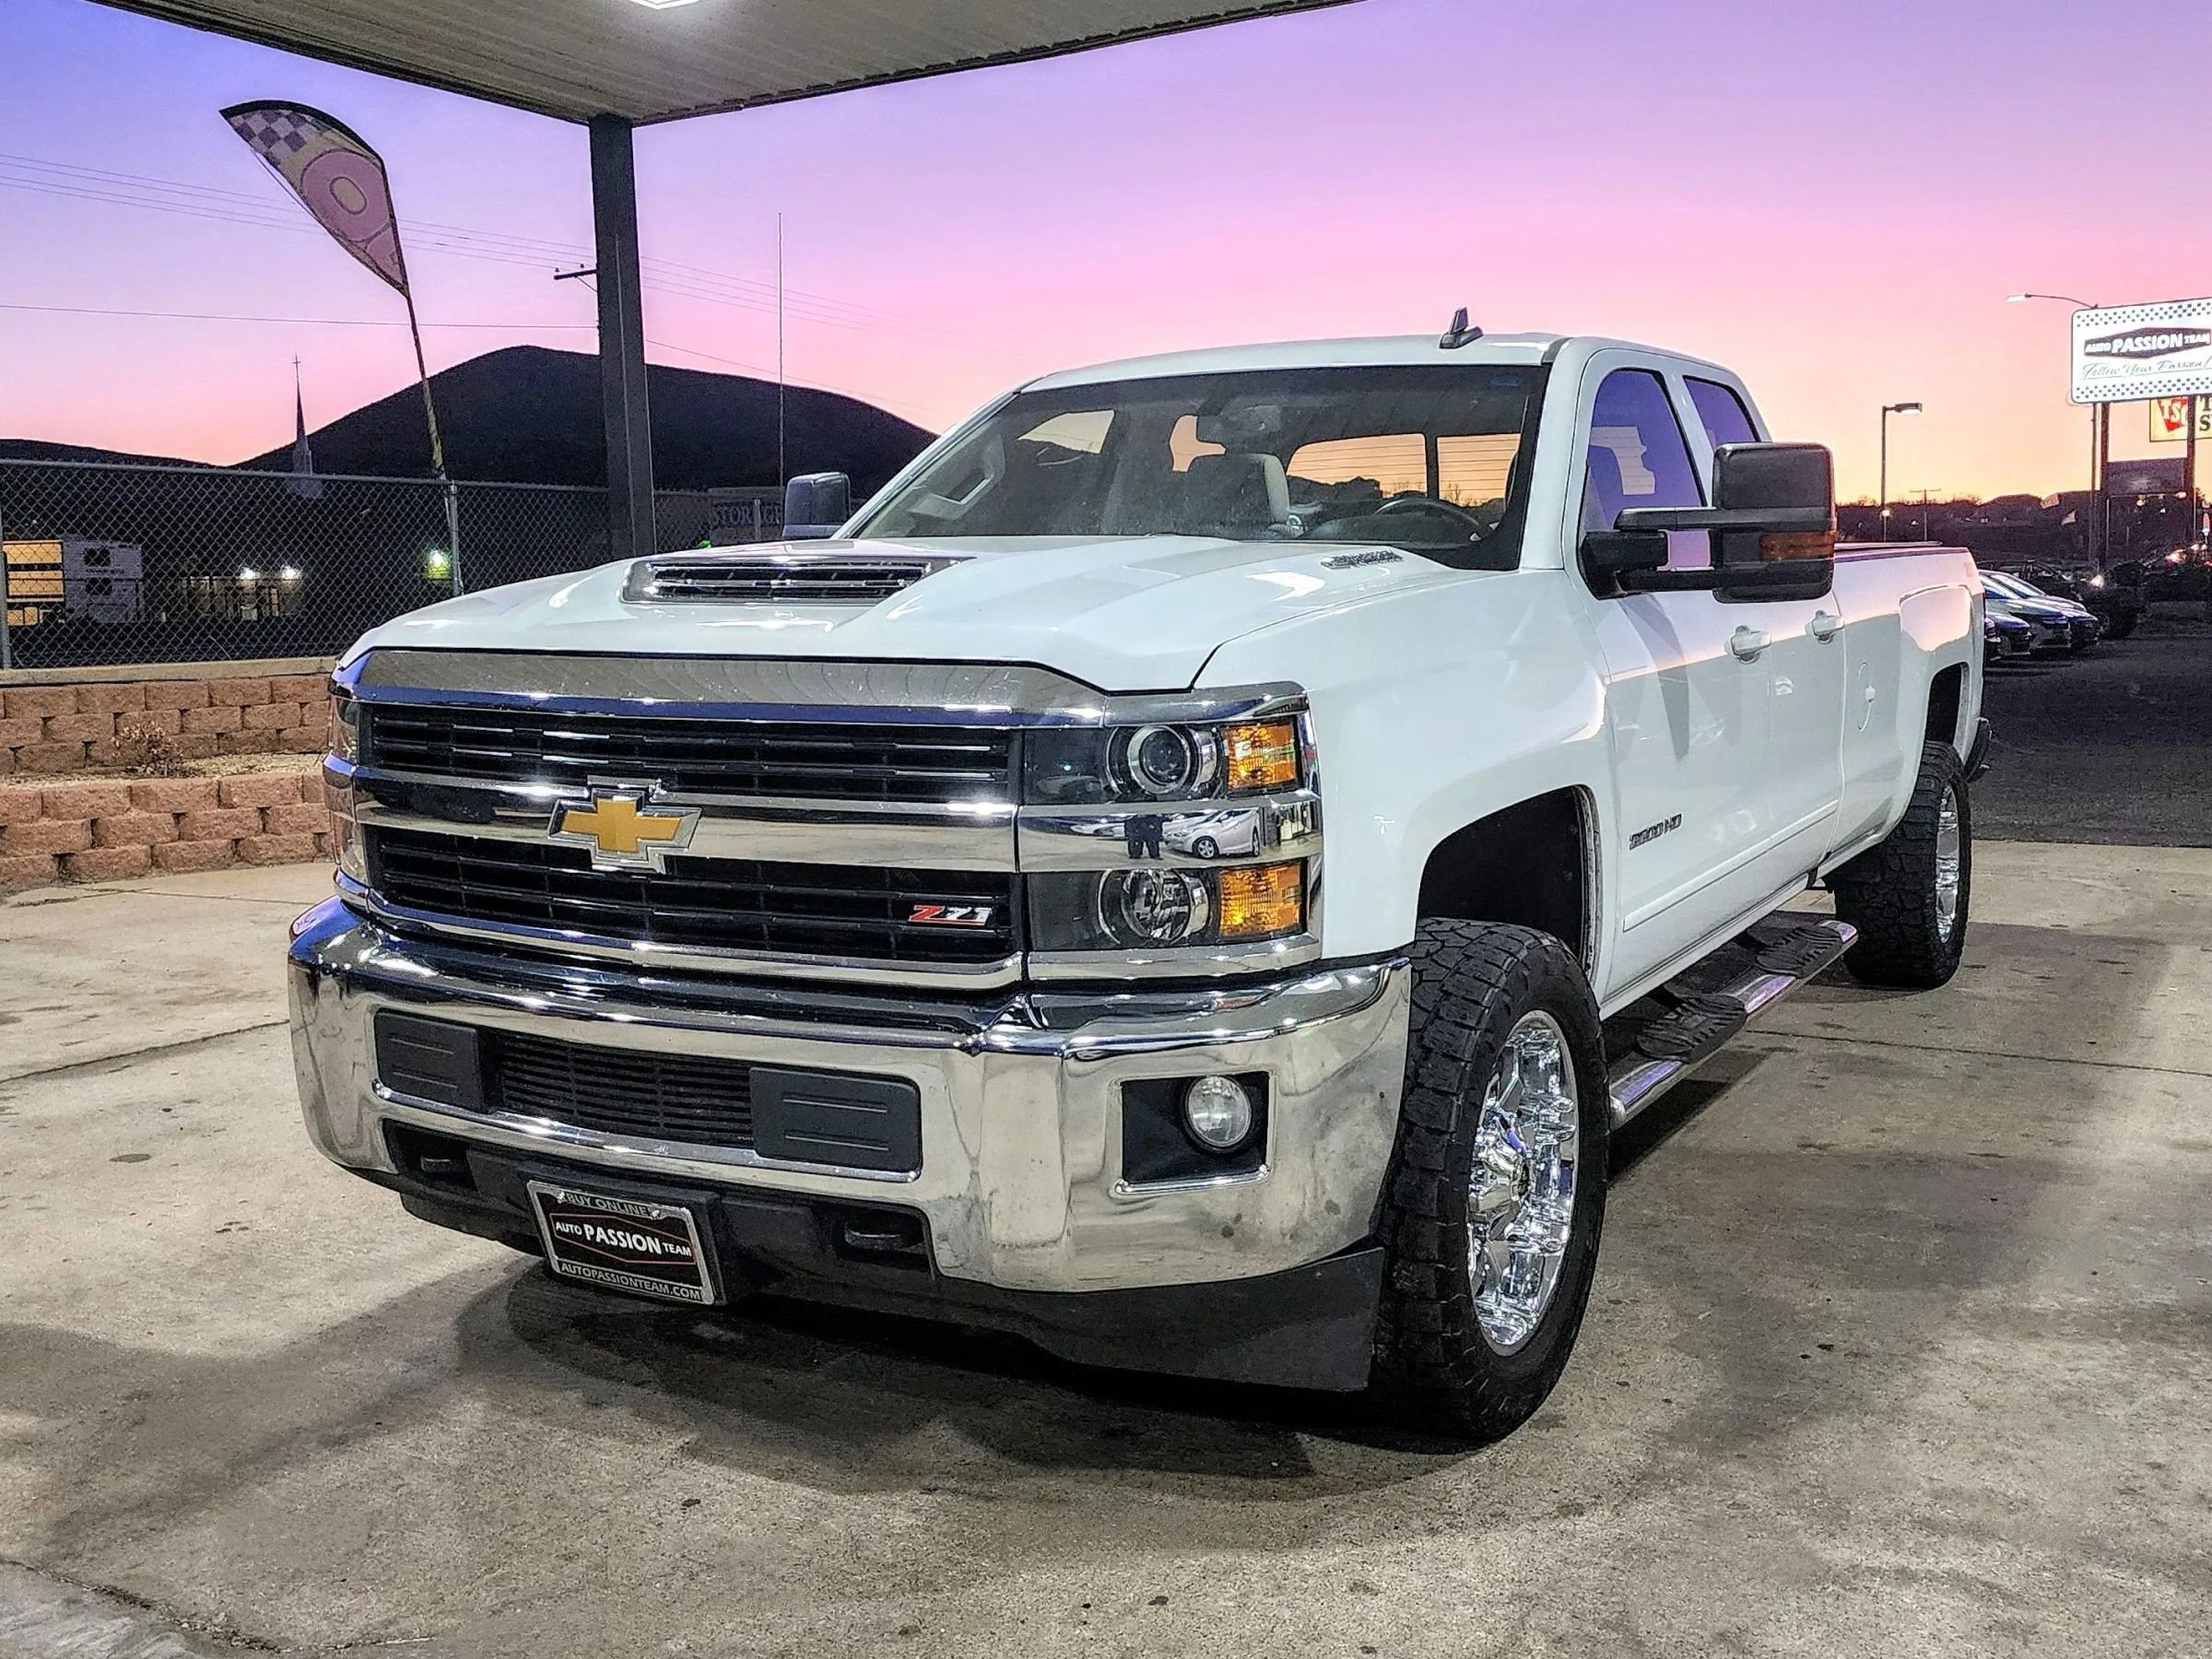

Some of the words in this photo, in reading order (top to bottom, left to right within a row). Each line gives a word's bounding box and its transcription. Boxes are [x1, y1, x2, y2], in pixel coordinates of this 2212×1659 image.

[2112, 333, 2183, 353] PASSION
[908, 904, 993, 926] Z71
[566, 1194, 592, 1207] BUY
[555, 1220, 582, 1236] AUTO
[582, 1223, 662, 1254] PASSION
[662, 1242, 692, 1257] TEAM
[561, 1262, 701, 1300] AUTOPASSIONTEAM.COM
